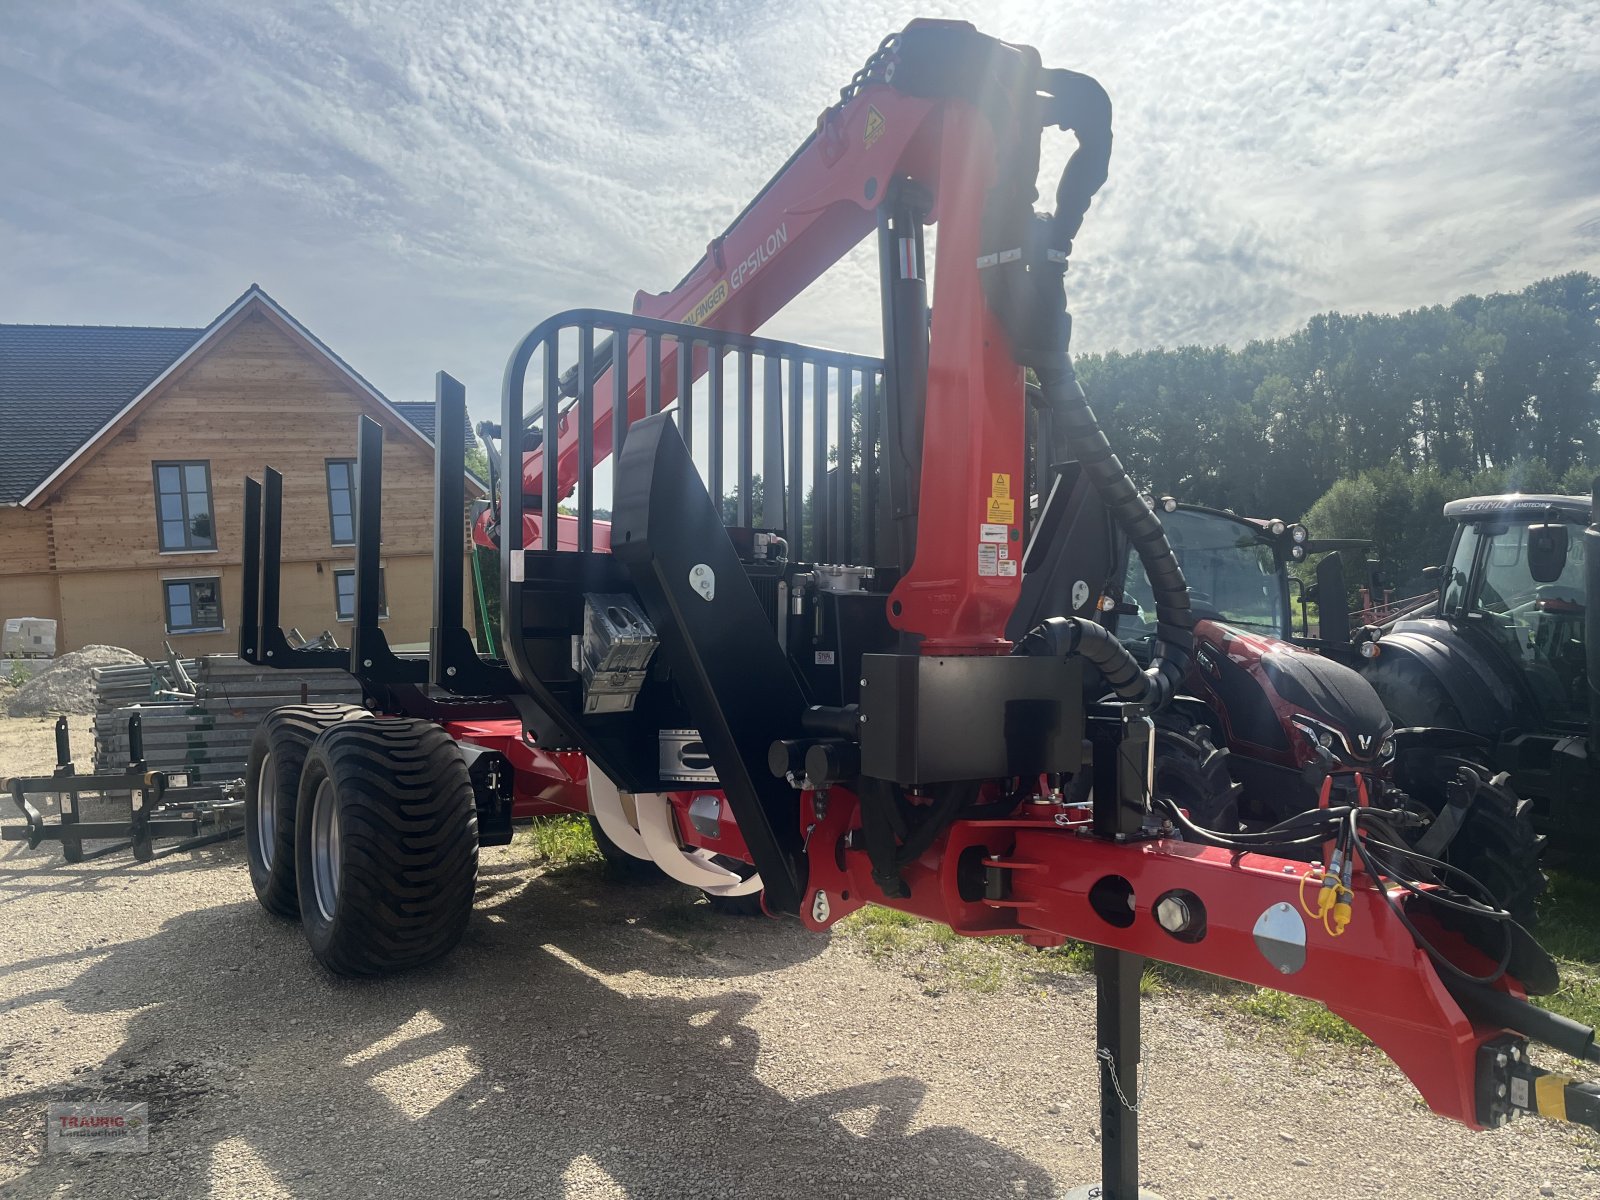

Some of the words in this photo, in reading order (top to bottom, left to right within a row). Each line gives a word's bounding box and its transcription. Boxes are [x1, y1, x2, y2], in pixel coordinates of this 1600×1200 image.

[683, 284, 725, 326] ALFINGER
[730, 222, 788, 290] EPSILON
[1462, 501, 1510, 512] SCHMID
